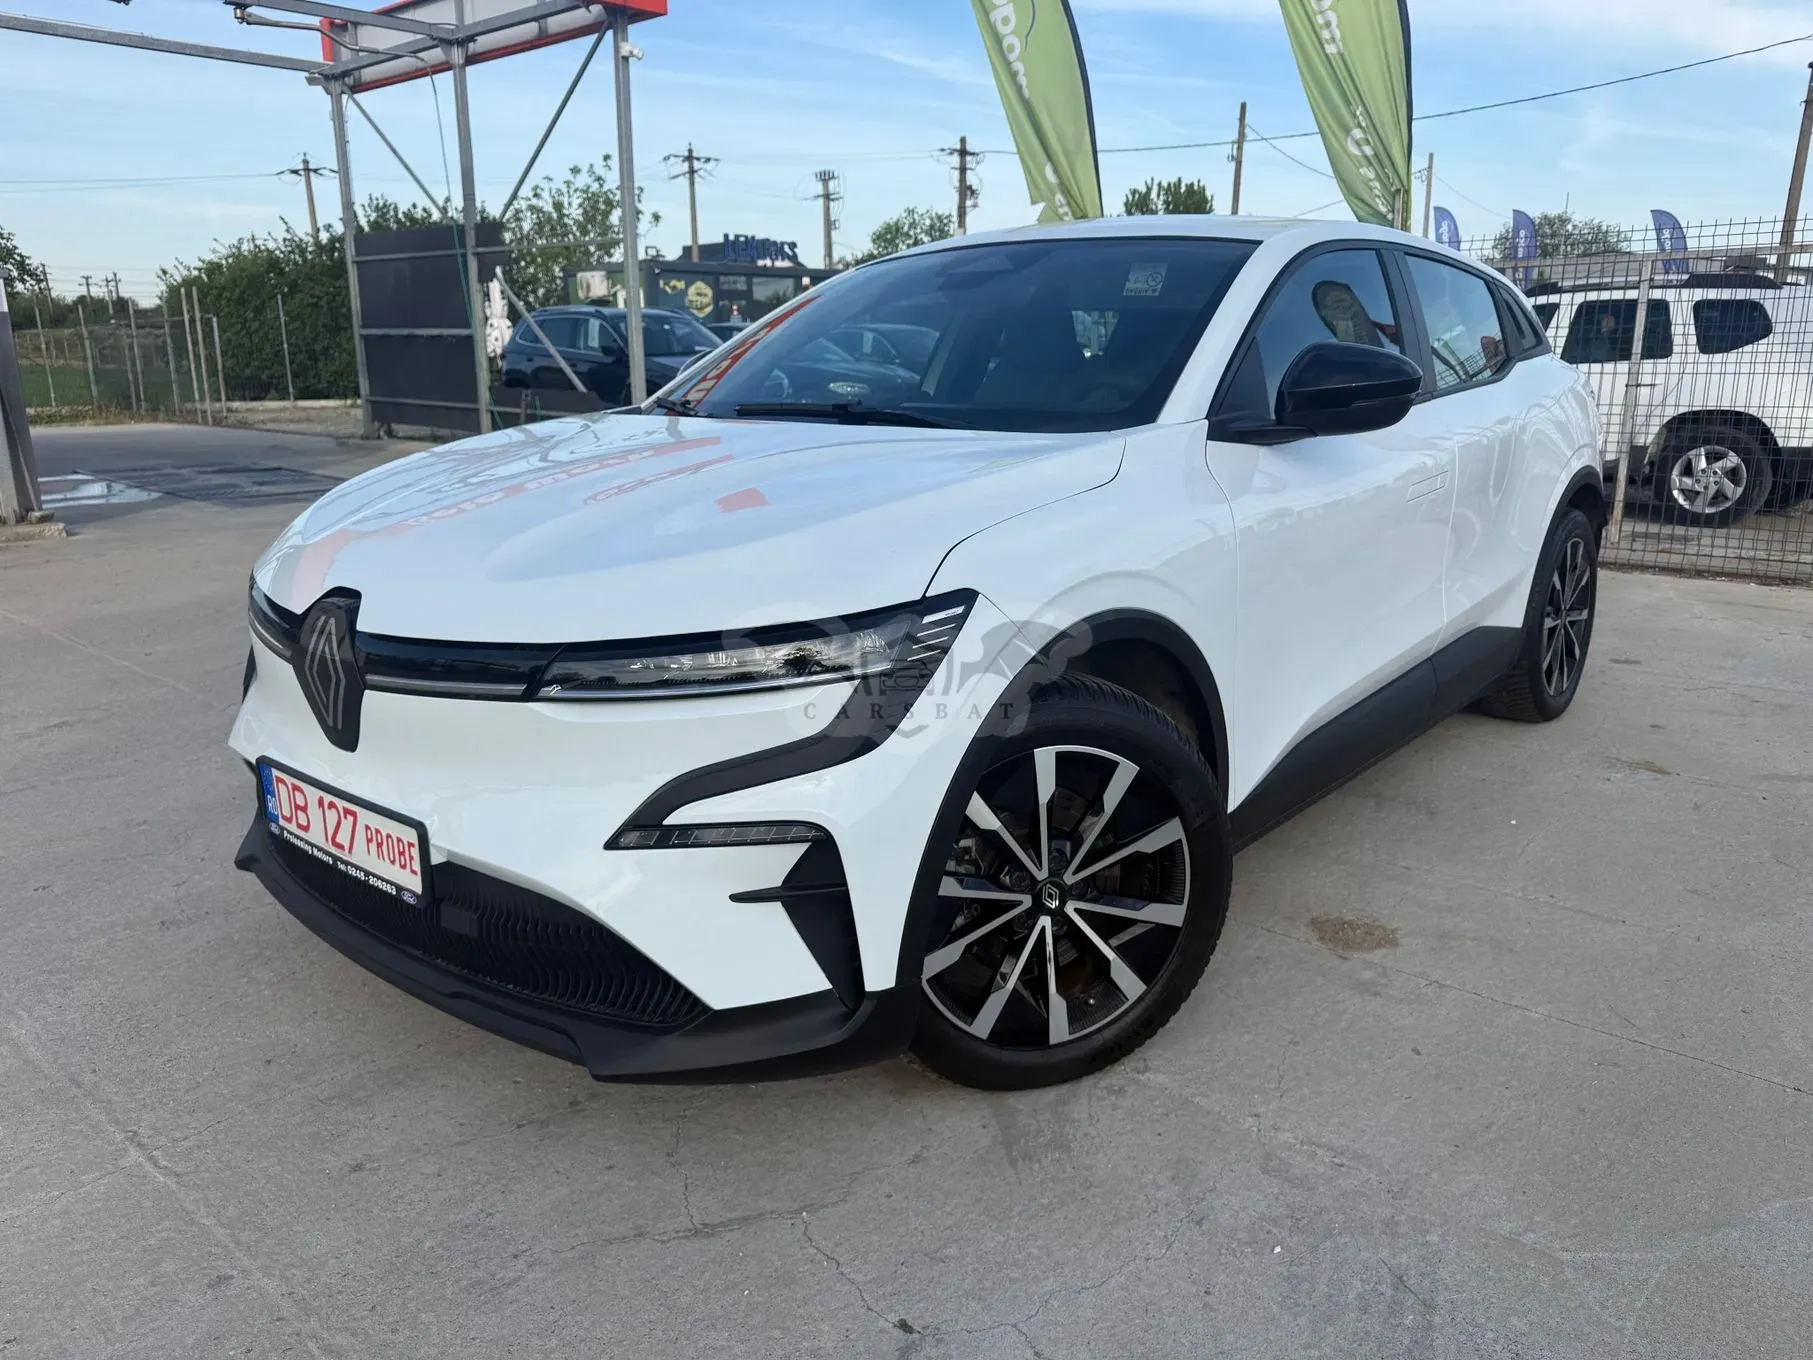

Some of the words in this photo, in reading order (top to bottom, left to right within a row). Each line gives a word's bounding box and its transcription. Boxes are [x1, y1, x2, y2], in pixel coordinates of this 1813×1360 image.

[267, 794, 278, 815] RO
[275, 775, 311, 833] DB
[318, 795, 358, 855] 127
[365, 823, 419, 876] PROBE
